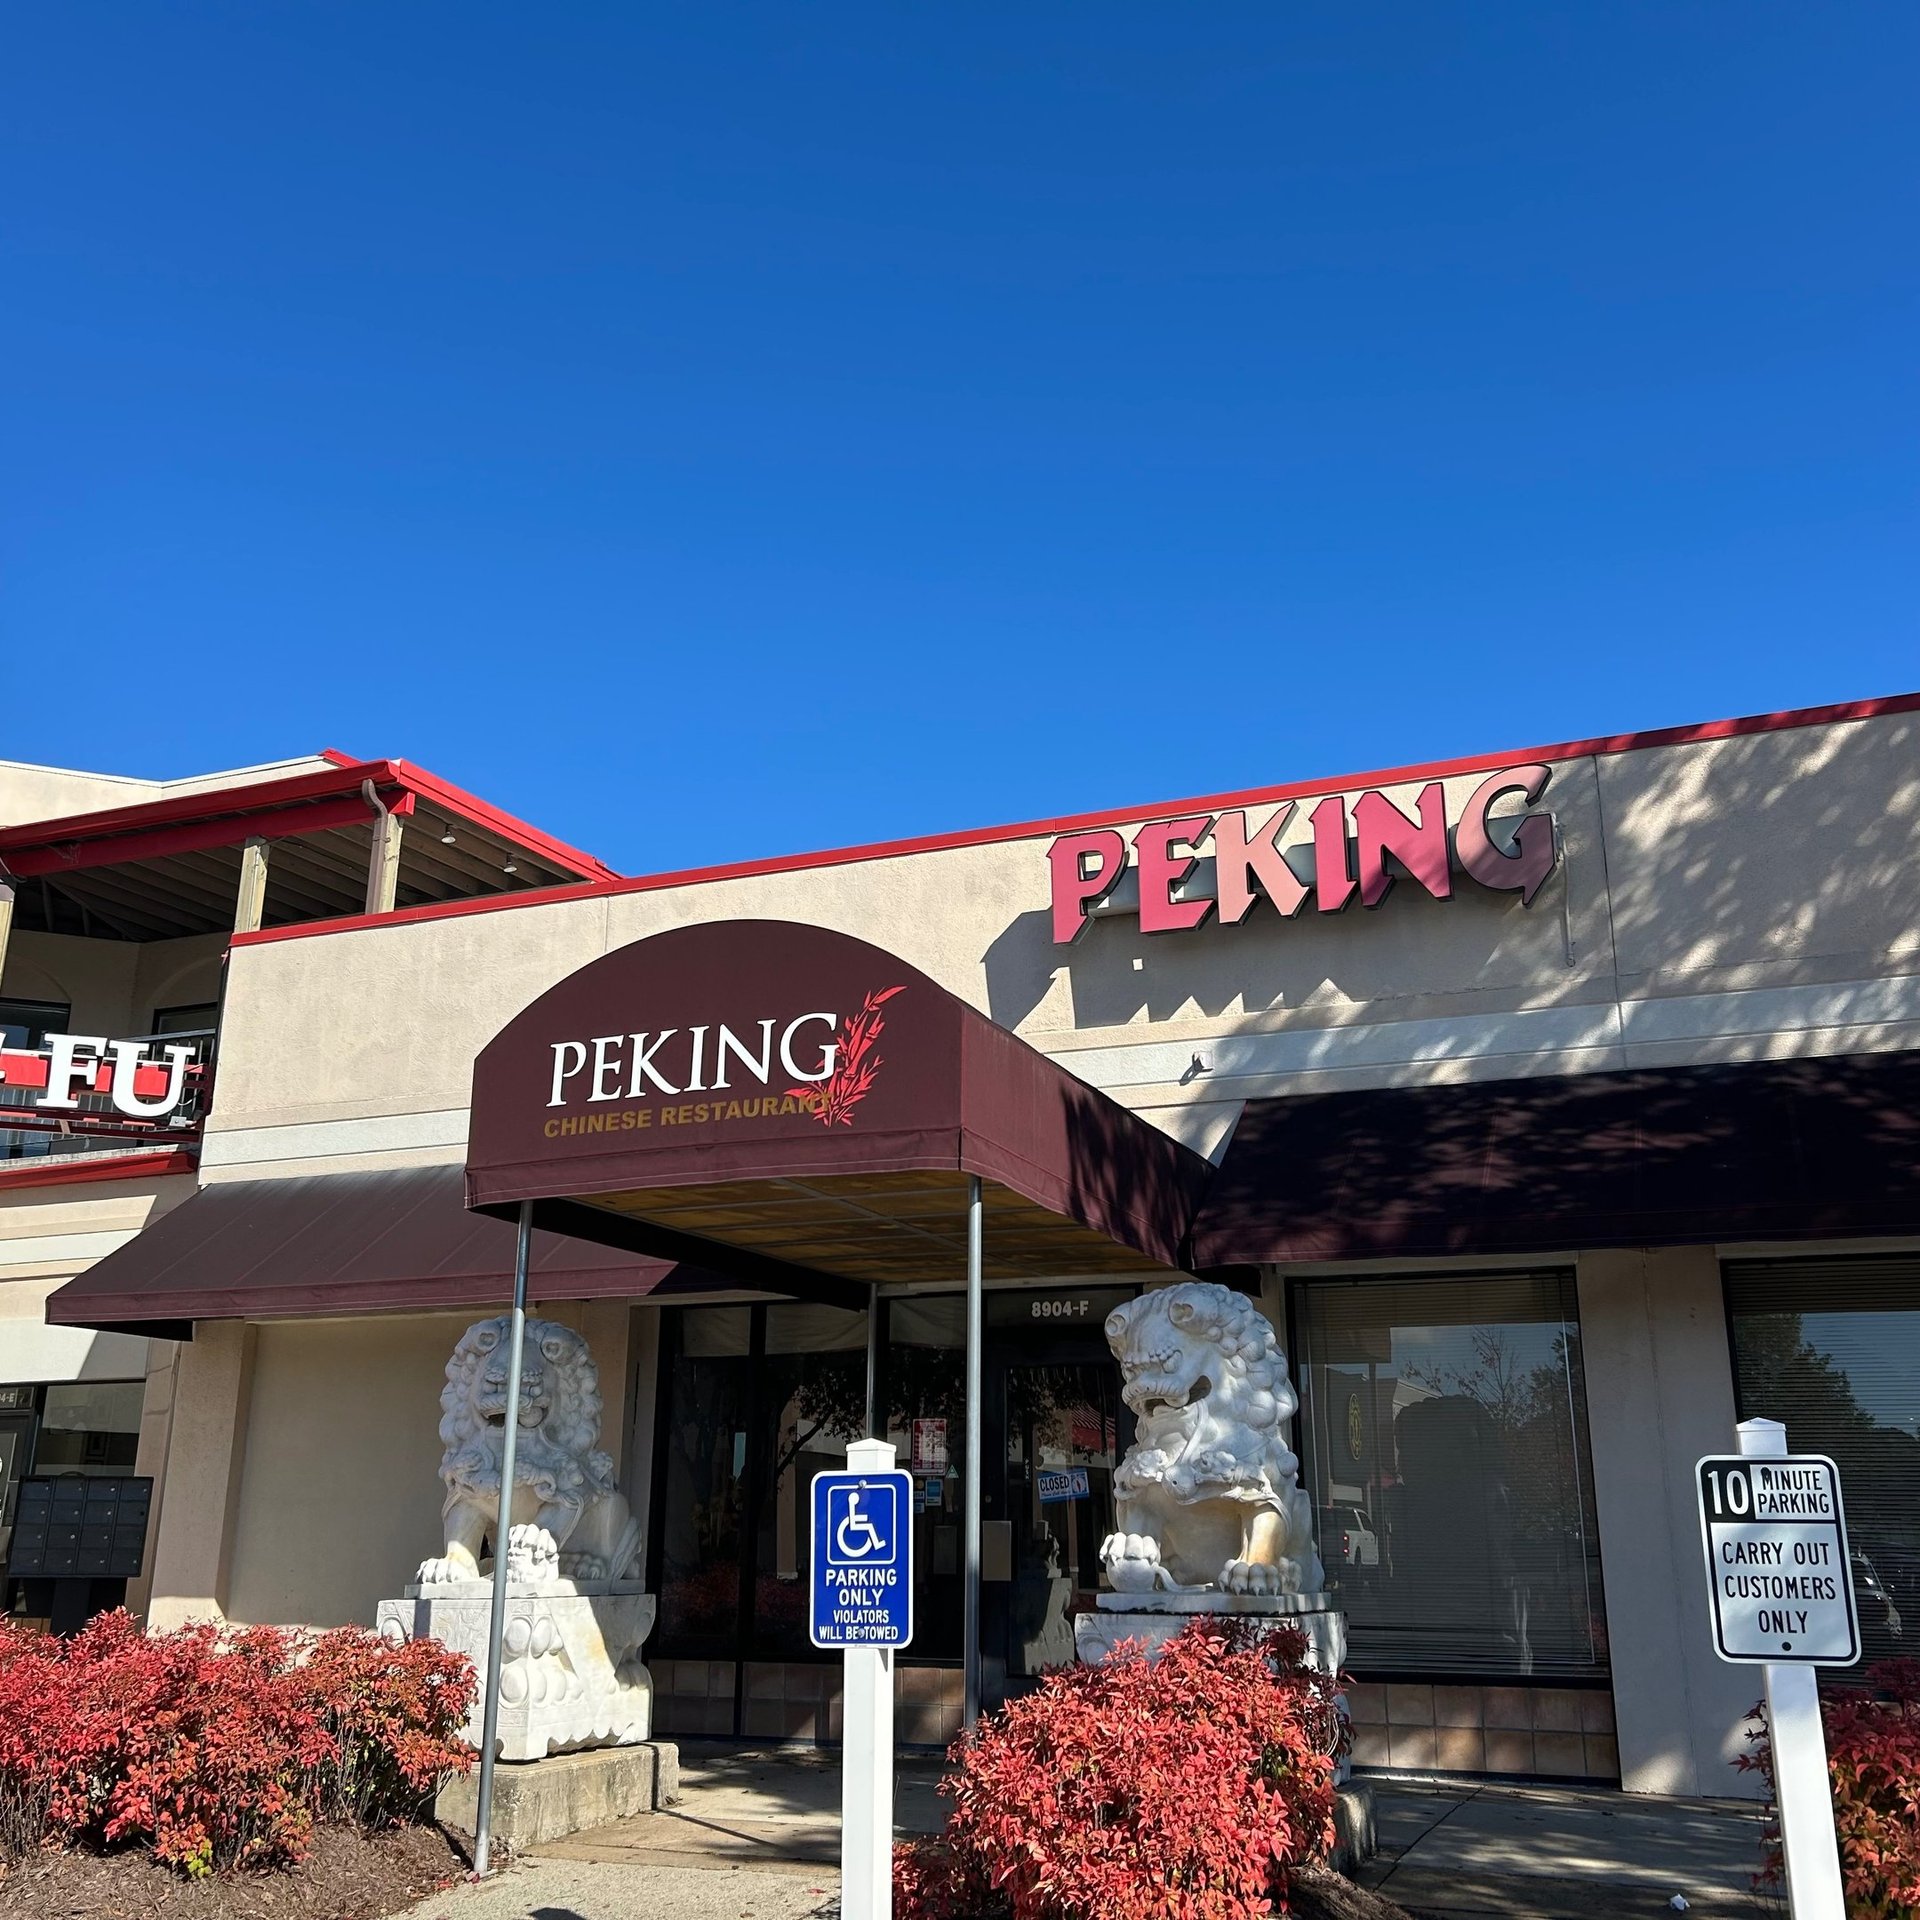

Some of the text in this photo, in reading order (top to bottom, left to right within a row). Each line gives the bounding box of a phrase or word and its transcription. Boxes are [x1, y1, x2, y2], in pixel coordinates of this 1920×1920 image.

[1046, 764, 1556, 944] PEKING
[545, 1012, 840, 1107] PEKING
[36, 1033, 196, 1117] FU
[543, 1092, 834, 1138] CHINESE RESTAURANT
[1031, 1300, 1089, 1318] 8904-F
[1040, 1475, 1070, 1492] CLOSED
[1761, 1470, 1823, 1491] MINUTE
[1708, 1470, 1750, 1515] 10
[1758, 1493, 1830, 1514] PARKING
[1722, 1541, 1829, 1565] CARRY OUT
[825, 1568, 897, 1587] PARKING
[1724, 1575, 1836, 1600] CUSTOMERS
[838, 1588, 884, 1606] ONLY
[833, 1609, 890, 1624] VIOLATORS
[1758, 1610, 1808, 1634] ONLY
[819, 1625, 899, 1640] WILL BE TOWED
